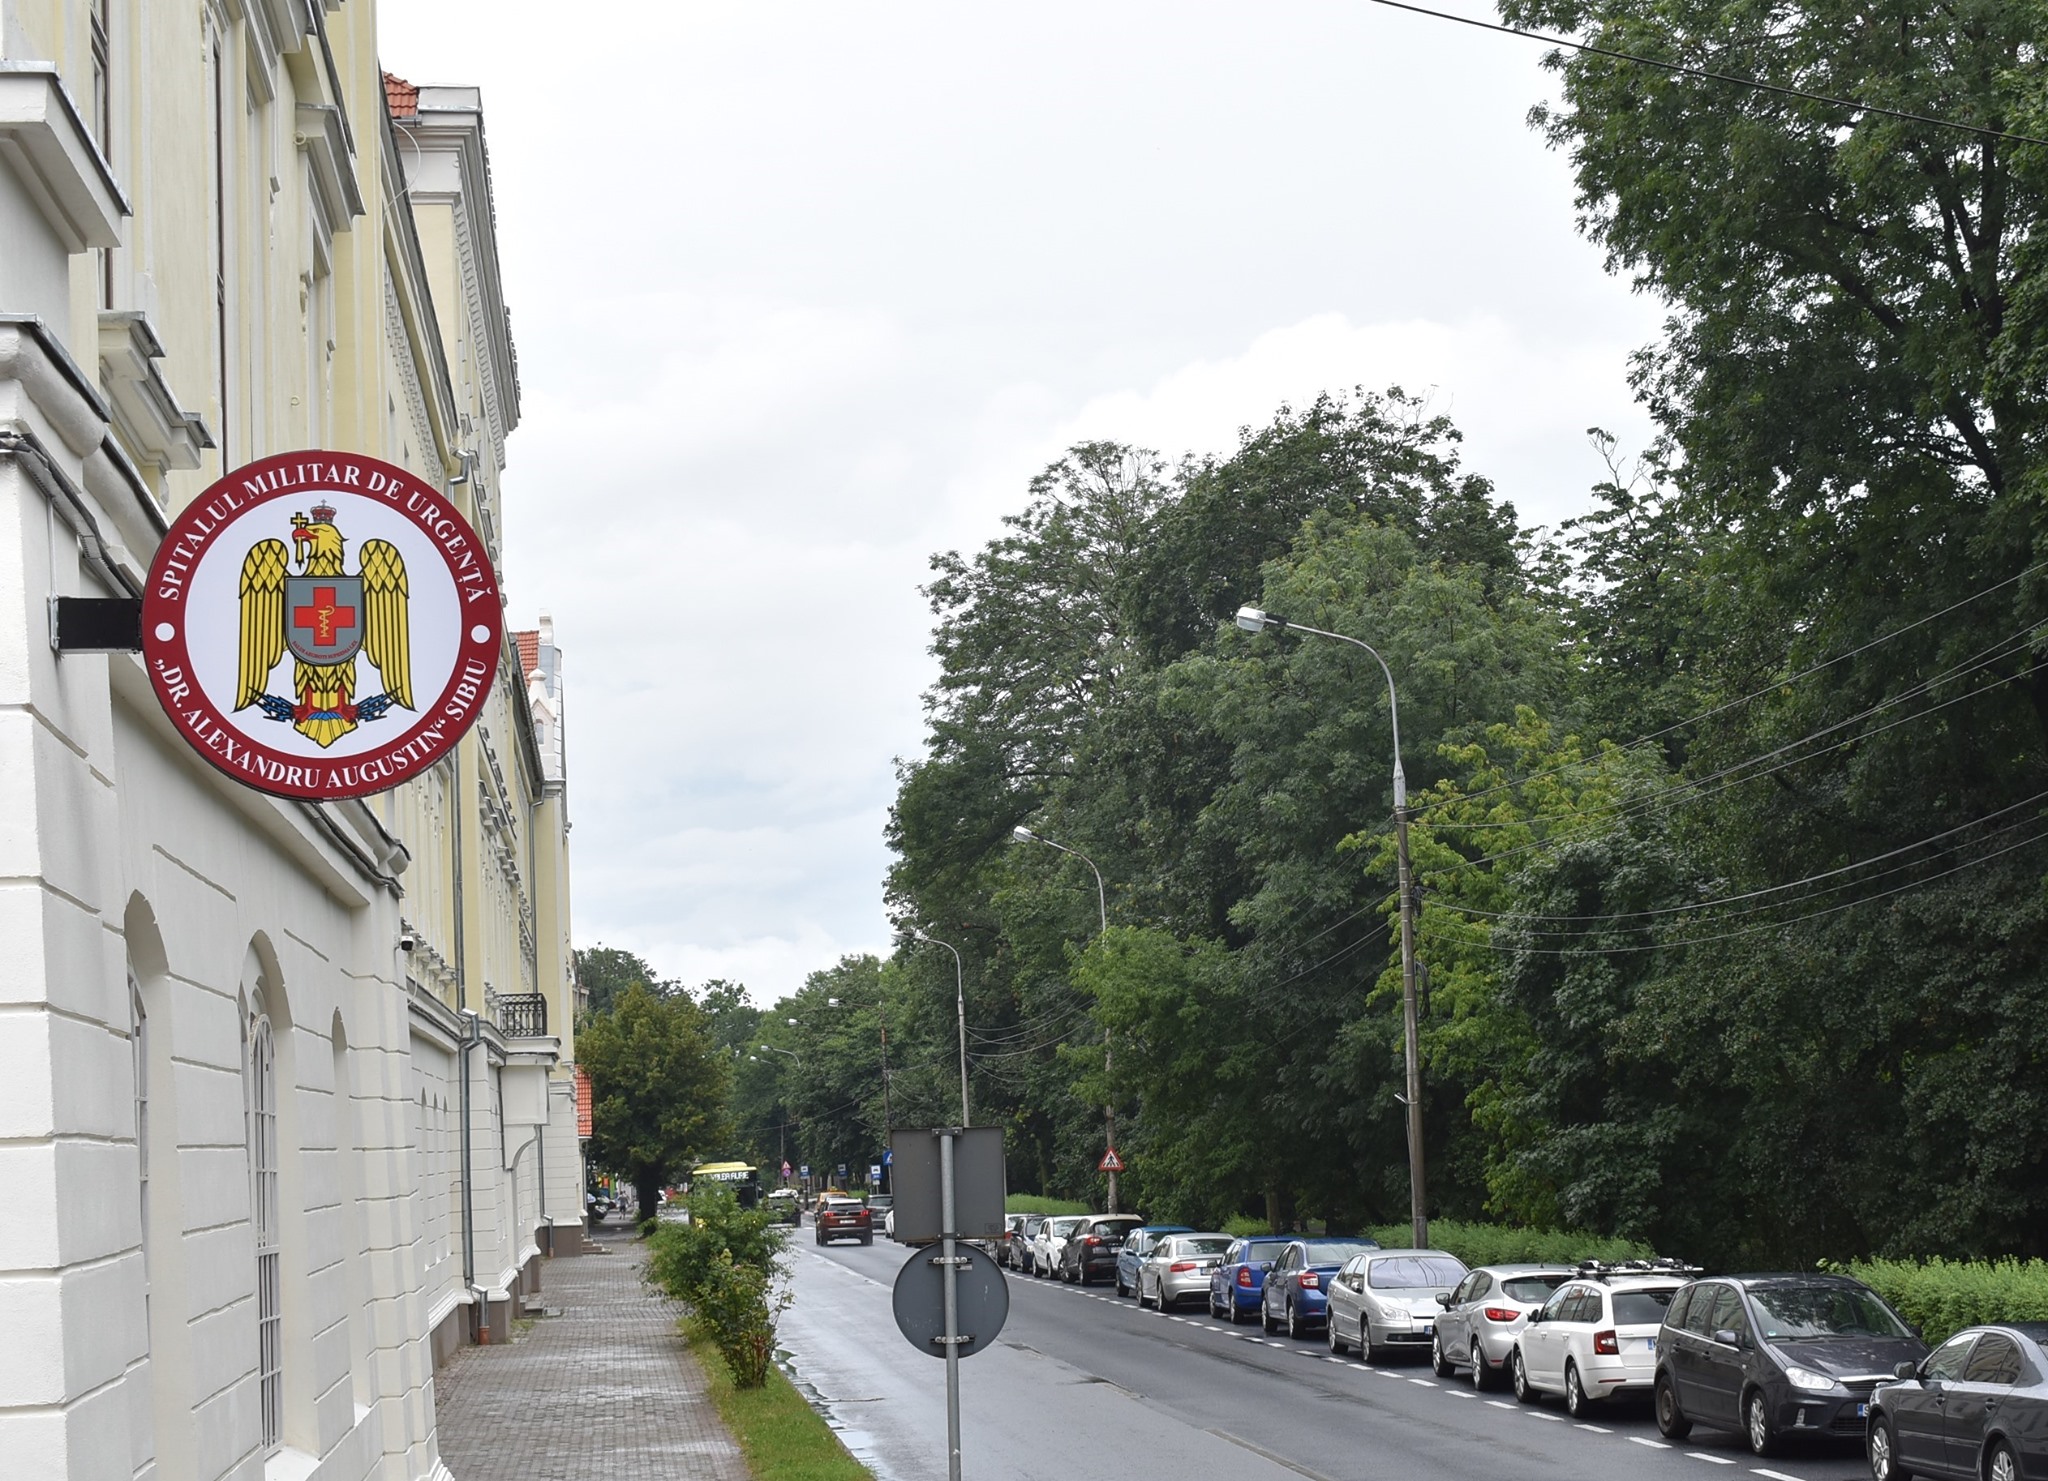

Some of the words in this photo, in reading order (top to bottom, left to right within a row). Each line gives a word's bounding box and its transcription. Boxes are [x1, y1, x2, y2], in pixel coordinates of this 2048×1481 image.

[159, 491, 244, 601] SPITALUL
[243, 463, 359, 499] MILITAR
[367, 472, 404, 500] DE
[407, 491, 492, 604] URGENȚĂ
[182, 710, 320, 787] ALEXANDRU
[448, 659, 486, 721] SIBIU
